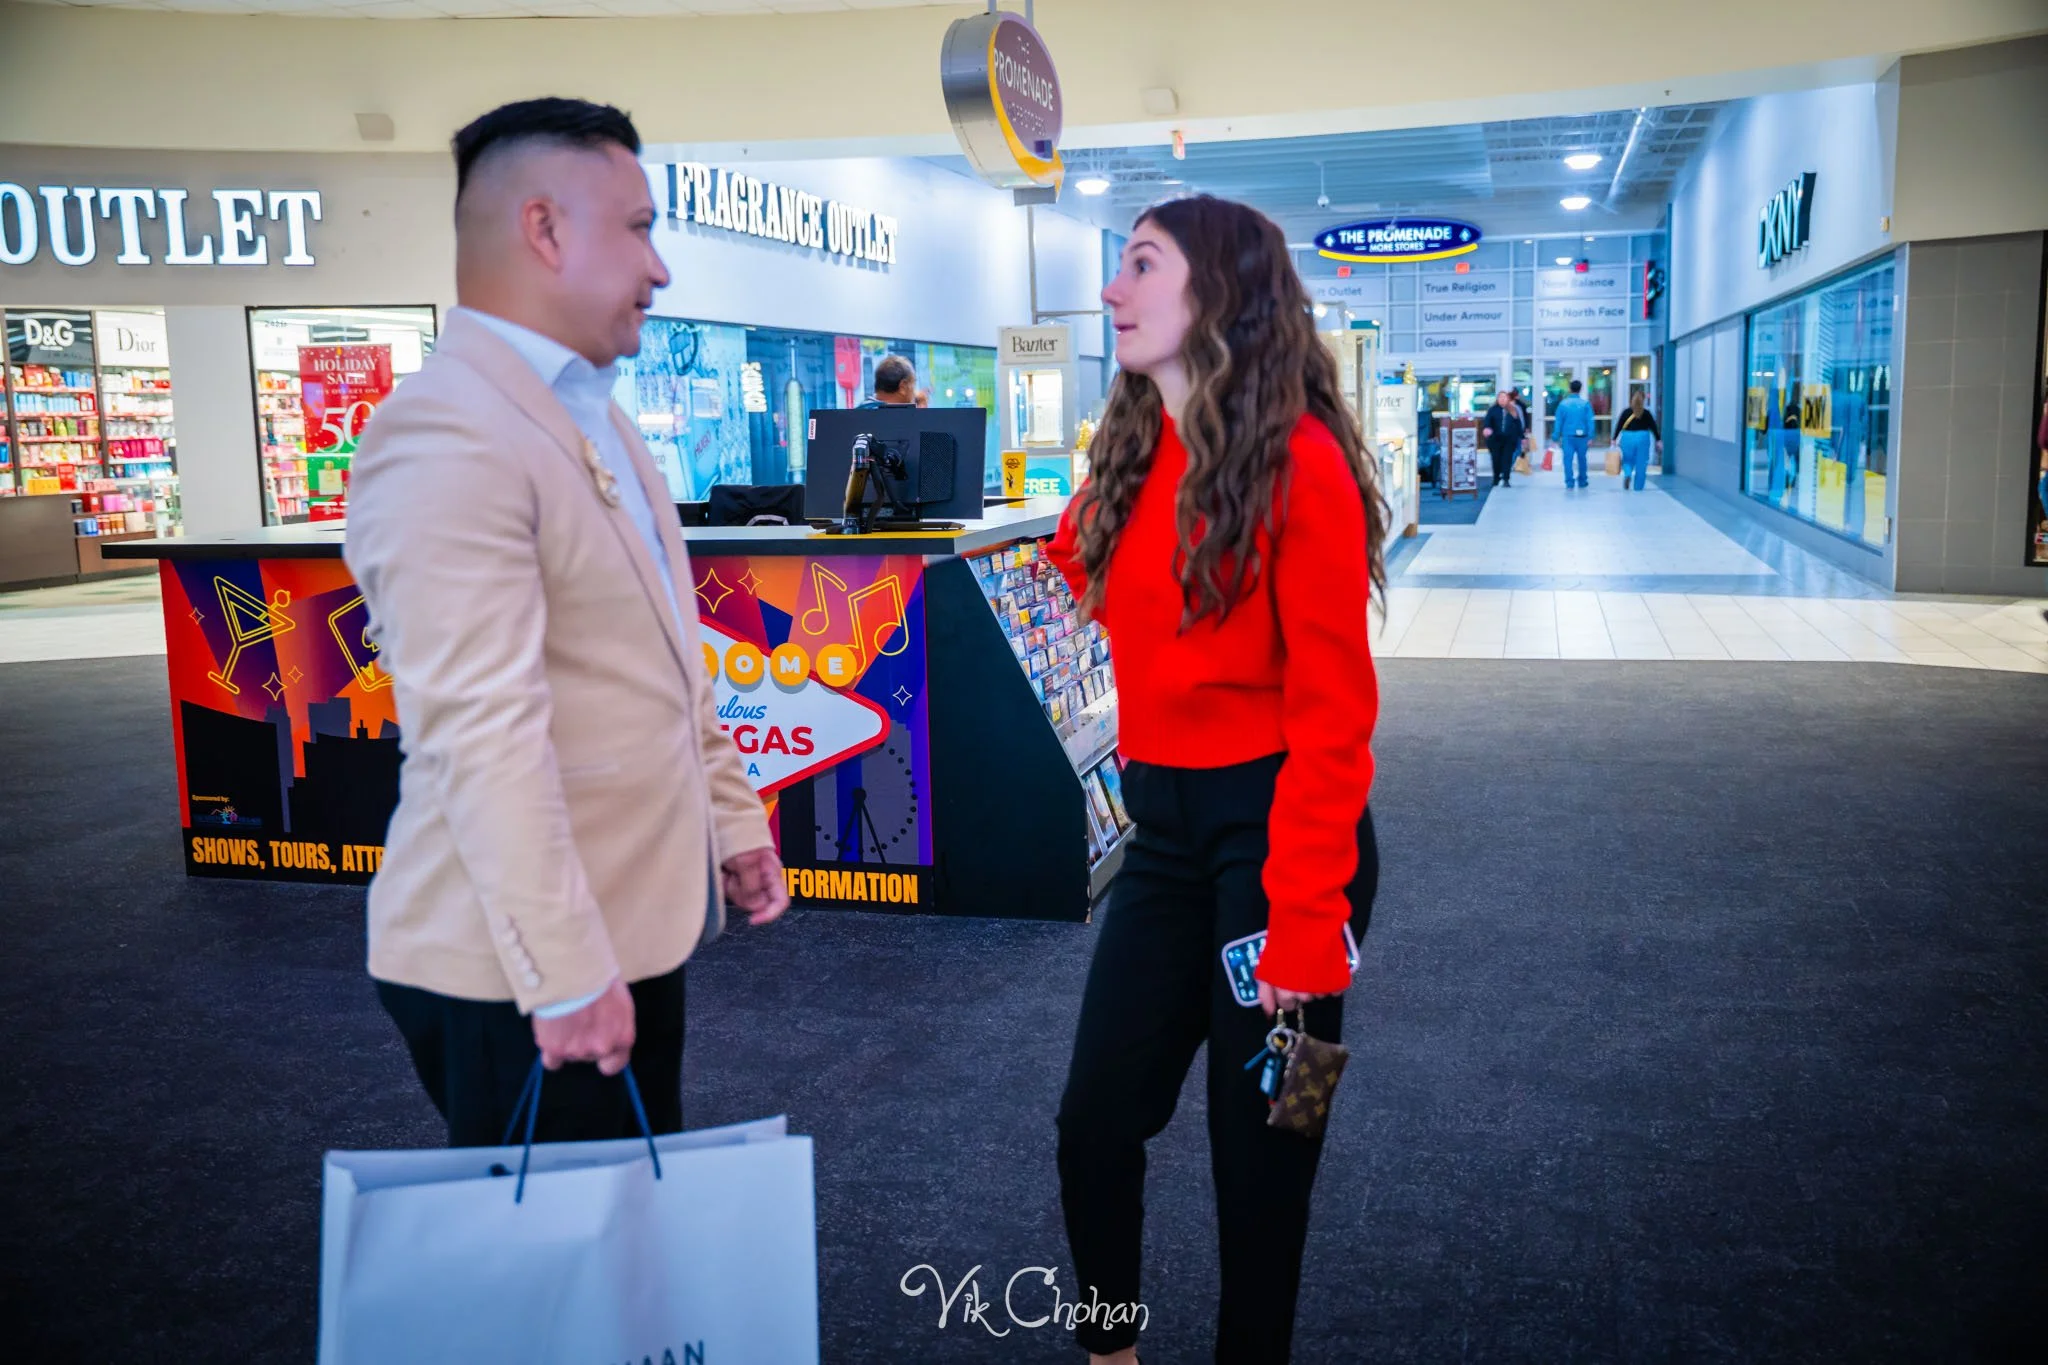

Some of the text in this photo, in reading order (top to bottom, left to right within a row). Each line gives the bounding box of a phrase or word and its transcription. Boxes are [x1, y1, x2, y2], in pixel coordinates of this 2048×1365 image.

[994, 47, 1053, 111] PROMENADE
[0, 181, 323, 266] OUTLET
[672, 161, 898, 264] FRAGRANCE OUTLET
[1758, 172, 1809, 268] DKNY
[1338, 226, 1452, 244] THE PROMENADE
[1369, 241, 1425, 253] MORE STORES
[1424, 281, 1496, 294] True Religion
[1424, 310, 1503, 322] Under Armour
[1598, 306, 1625, 316] Face
[24, 318, 75, 347] D&G
[116, 326, 156, 352] Dior
[1424, 337, 1457, 348] Guess
[1567, 336, 1600, 347] Stand
[1012, 335, 1058, 353] Banter
[313, 356, 378, 372] HOLIDAY
[735, 654, 844, 676] OME
[716, 694, 768, 720] ulous
[720, 724, 815, 756] GAS
[191, 836, 266, 870] SHOWS,
[268, 840, 337, 874] TOURS,
